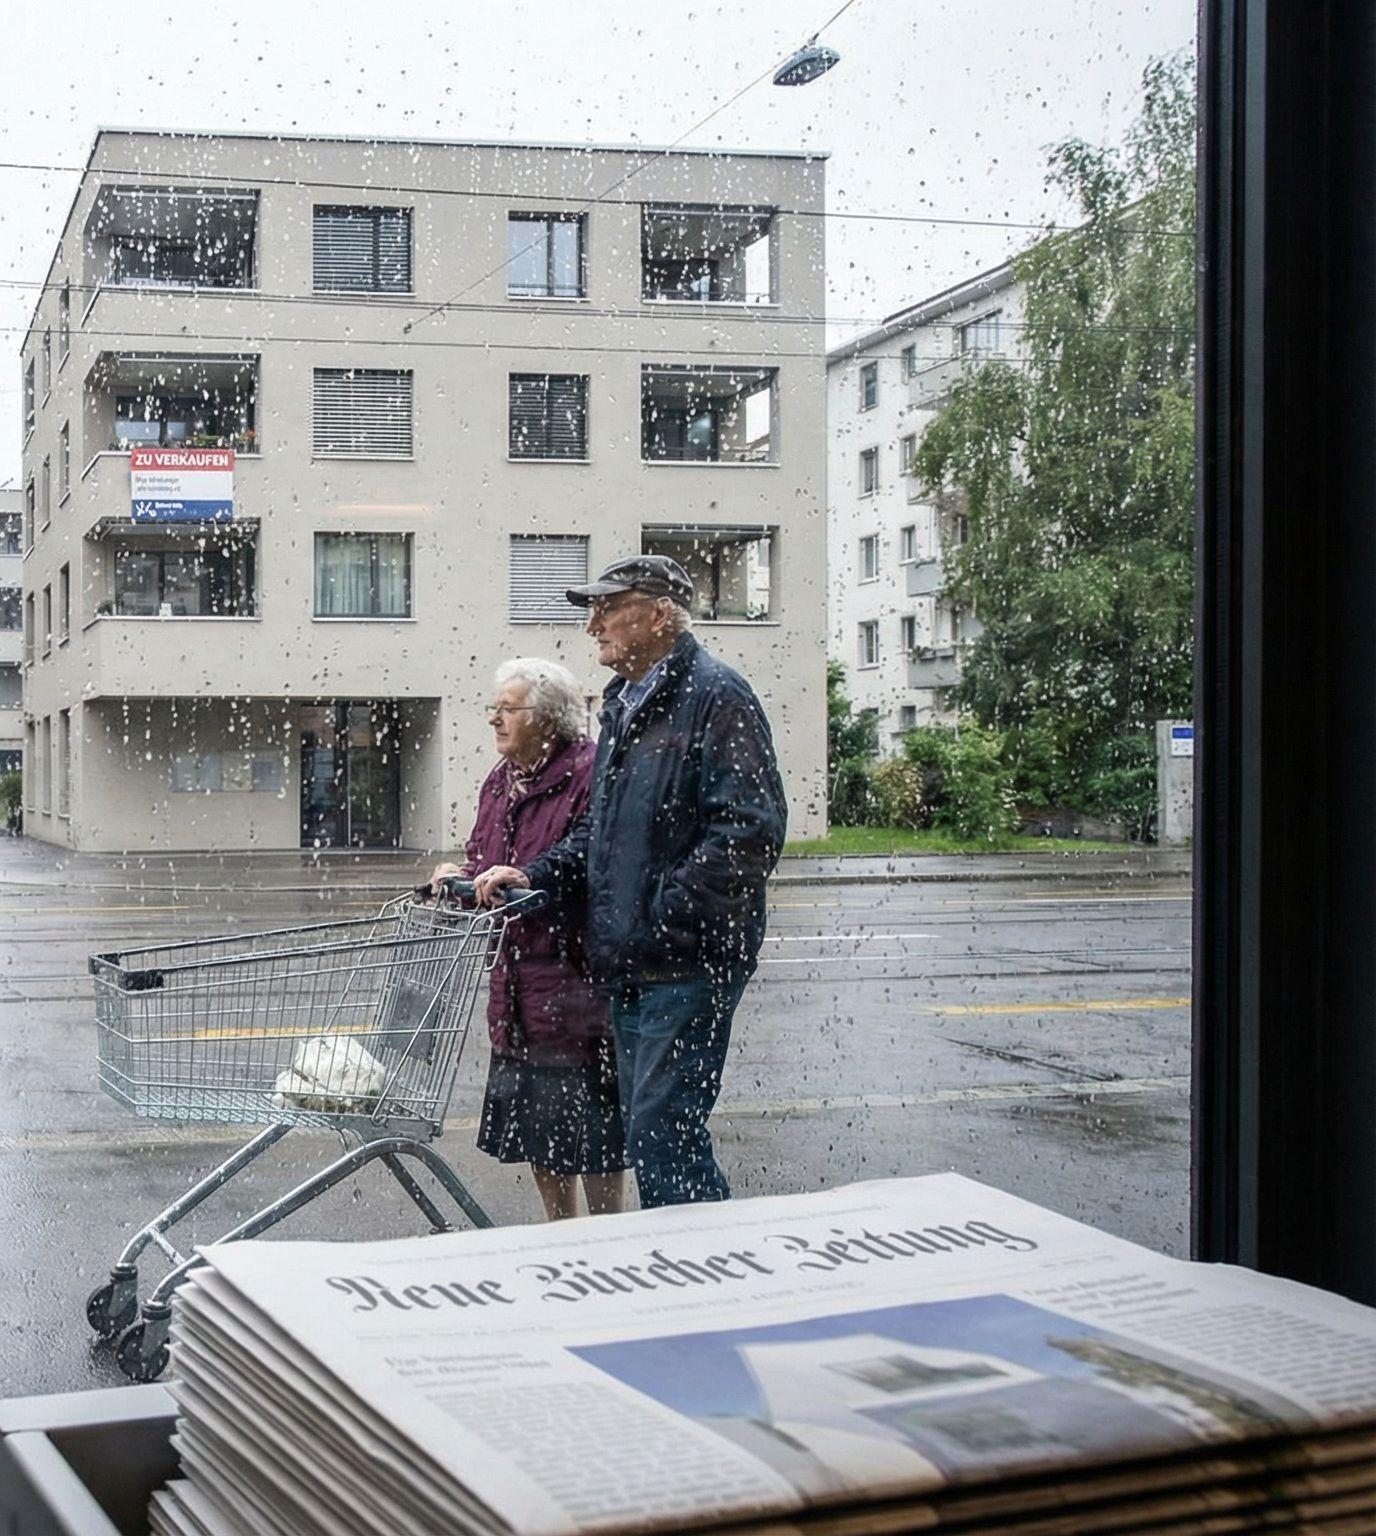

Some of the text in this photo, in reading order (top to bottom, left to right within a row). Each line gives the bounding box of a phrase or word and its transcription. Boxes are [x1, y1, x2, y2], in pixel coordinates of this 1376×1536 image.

[135, 453, 229, 467] ZU VERKAUFEN
[325, 1274, 516, 1314] Neue
[516, 1248, 774, 1303] Zürcher
[764, 1219, 1039, 1272] Zeitung
